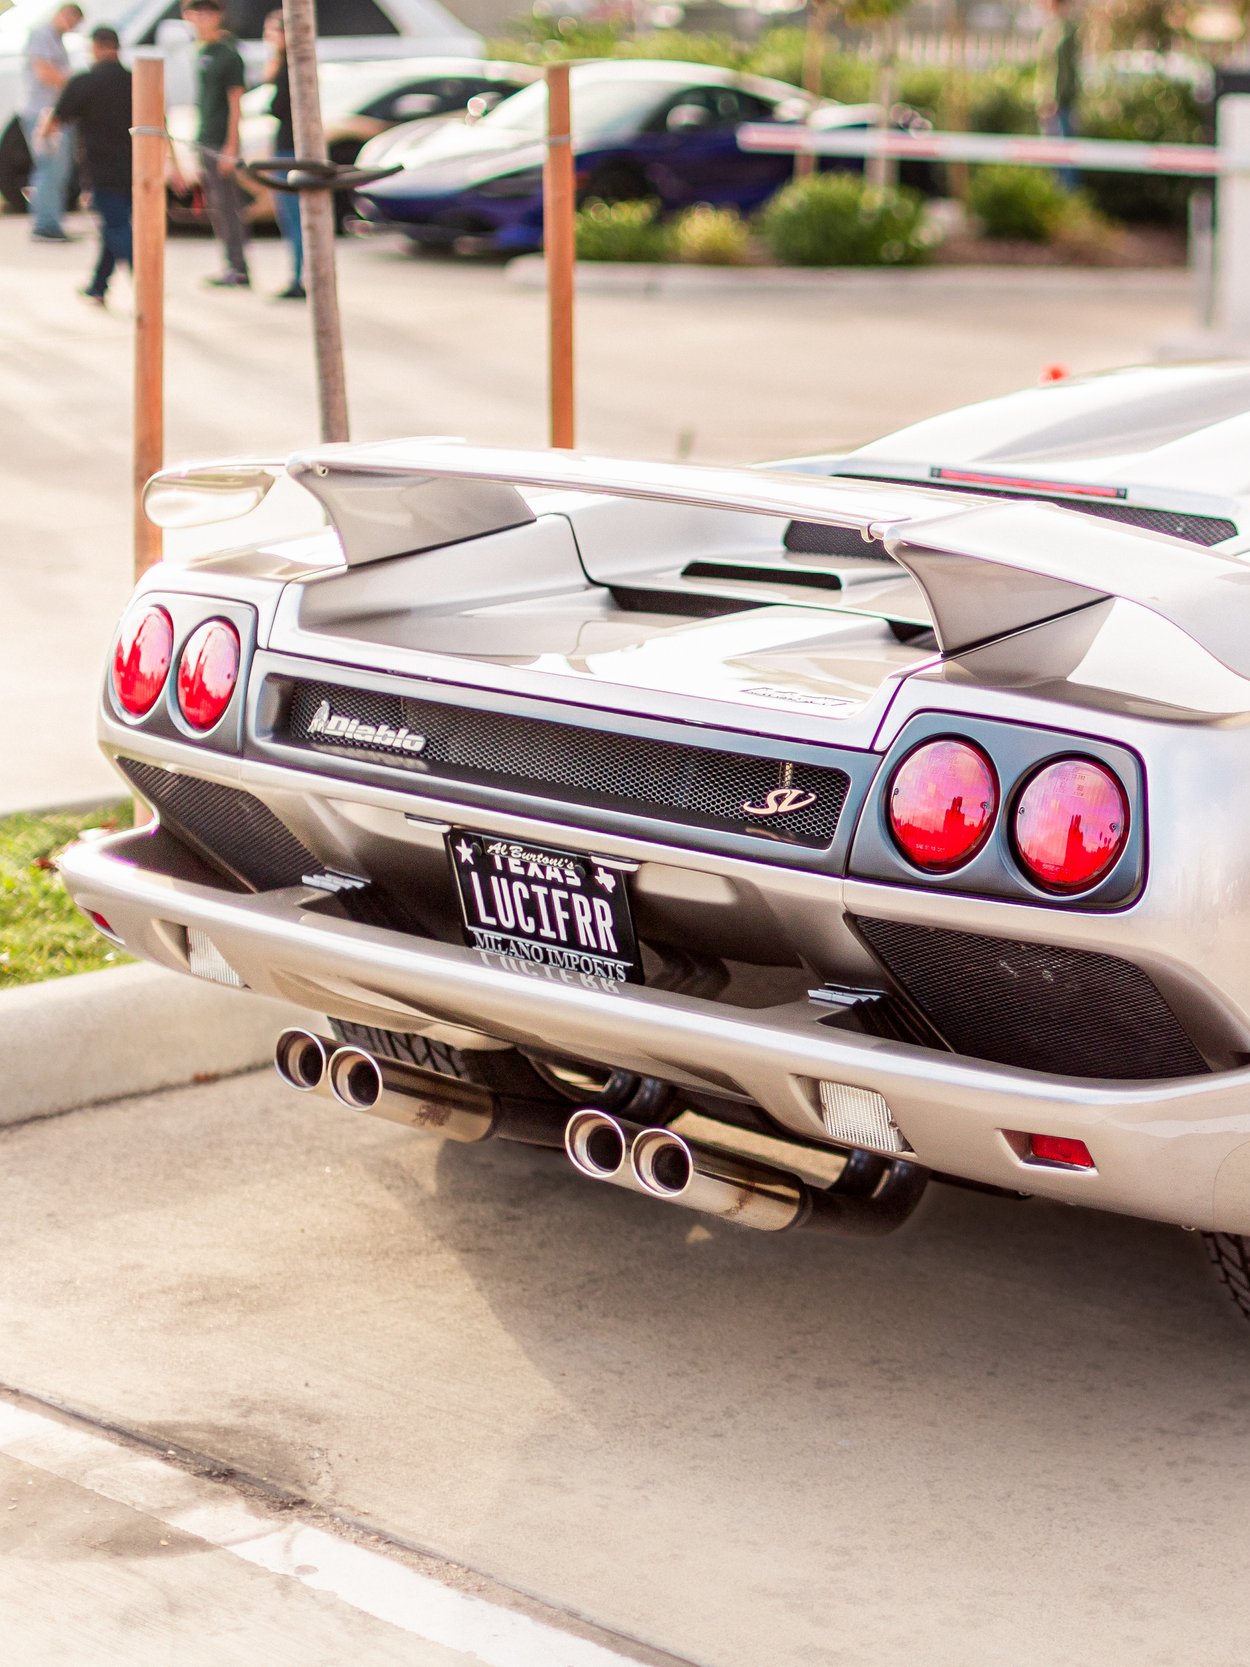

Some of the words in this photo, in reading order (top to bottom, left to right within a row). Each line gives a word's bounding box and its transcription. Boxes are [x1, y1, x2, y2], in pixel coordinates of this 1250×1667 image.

[323, 715, 427, 752] Diablo
[743, 788, 817, 815] SV
[487, 842, 508, 854] Al
[494, 854, 581, 887] TEXAS
[471, 871, 618, 953] LUCIFRR
[473, 931, 544, 963] MILANO
[546, 949, 626, 983] IMPORTS
